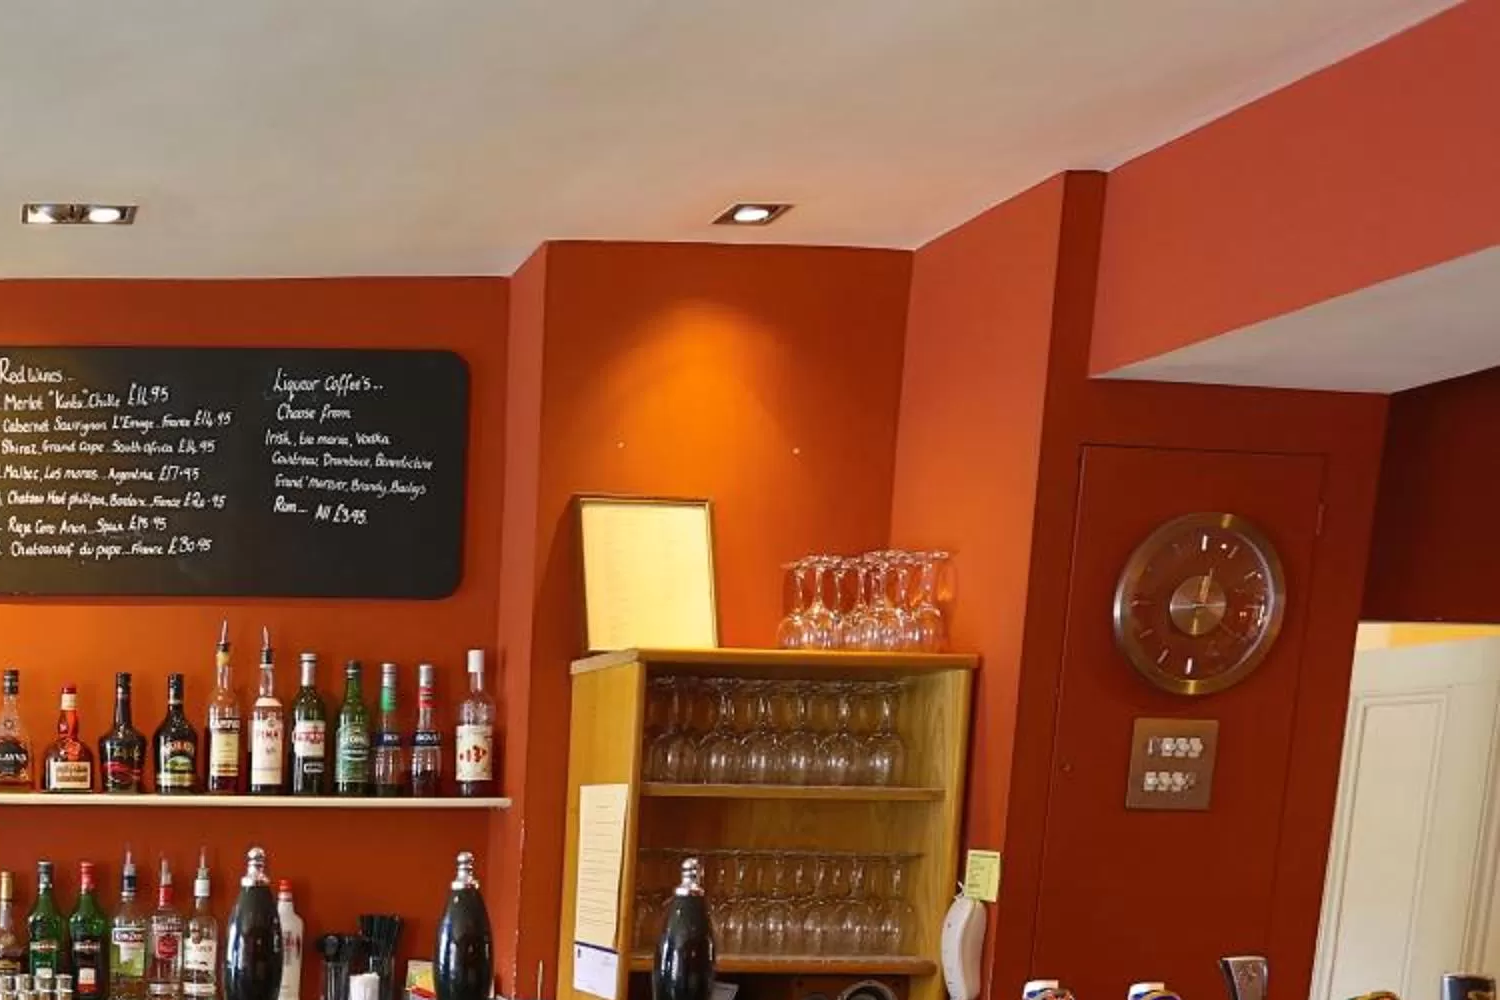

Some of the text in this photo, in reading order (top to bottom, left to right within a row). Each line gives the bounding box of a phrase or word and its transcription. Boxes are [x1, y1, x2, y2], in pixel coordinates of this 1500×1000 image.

[4, 393, 44, 411] Merlot
[277, 403, 316, 420] Choose
[3, 416, 49, 433] Cabernet
